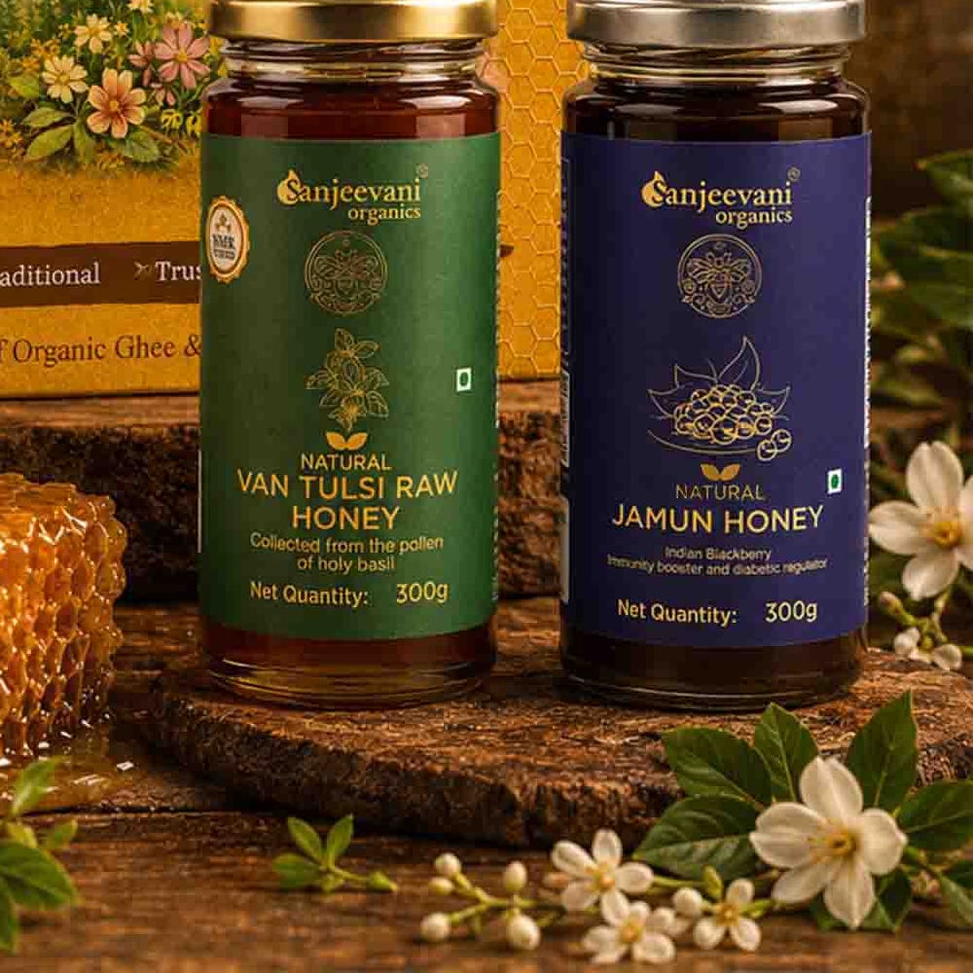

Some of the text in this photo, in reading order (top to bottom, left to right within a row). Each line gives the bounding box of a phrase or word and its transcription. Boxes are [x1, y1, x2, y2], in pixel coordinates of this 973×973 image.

[276, 168, 421, 210] Sanjeevani
[640, 171, 792, 213] Sanjeevani
[347, 204, 421, 225] organics
[715, 207, 793, 229] organics
[12, 338, 106, 372] Organic
[113, 335, 175, 360] Ghee
[182, 336, 201, 358] &
[300, 454, 392, 471] NATURAL
[236, 469, 458, 499] VAN TULSI RAW
[675, 484, 766, 500] NATURAL
[292, 506, 400, 530] HONEY
[611, 503, 824, 533] JAMUN HONEY
[250, 532, 444, 555] Collected from the pollen
[665, 546, 771, 563] Indian Blackberry
[297, 556, 395, 576] of holy basil
[657, 562, 702, 574] booster
[706, 563, 730, 575] and
[733, 561, 780, 575] diabetic
[250, 581, 450, 608] Net Quantity: 300g
[617, 598, 818, 628] Net Quantity: 300g
